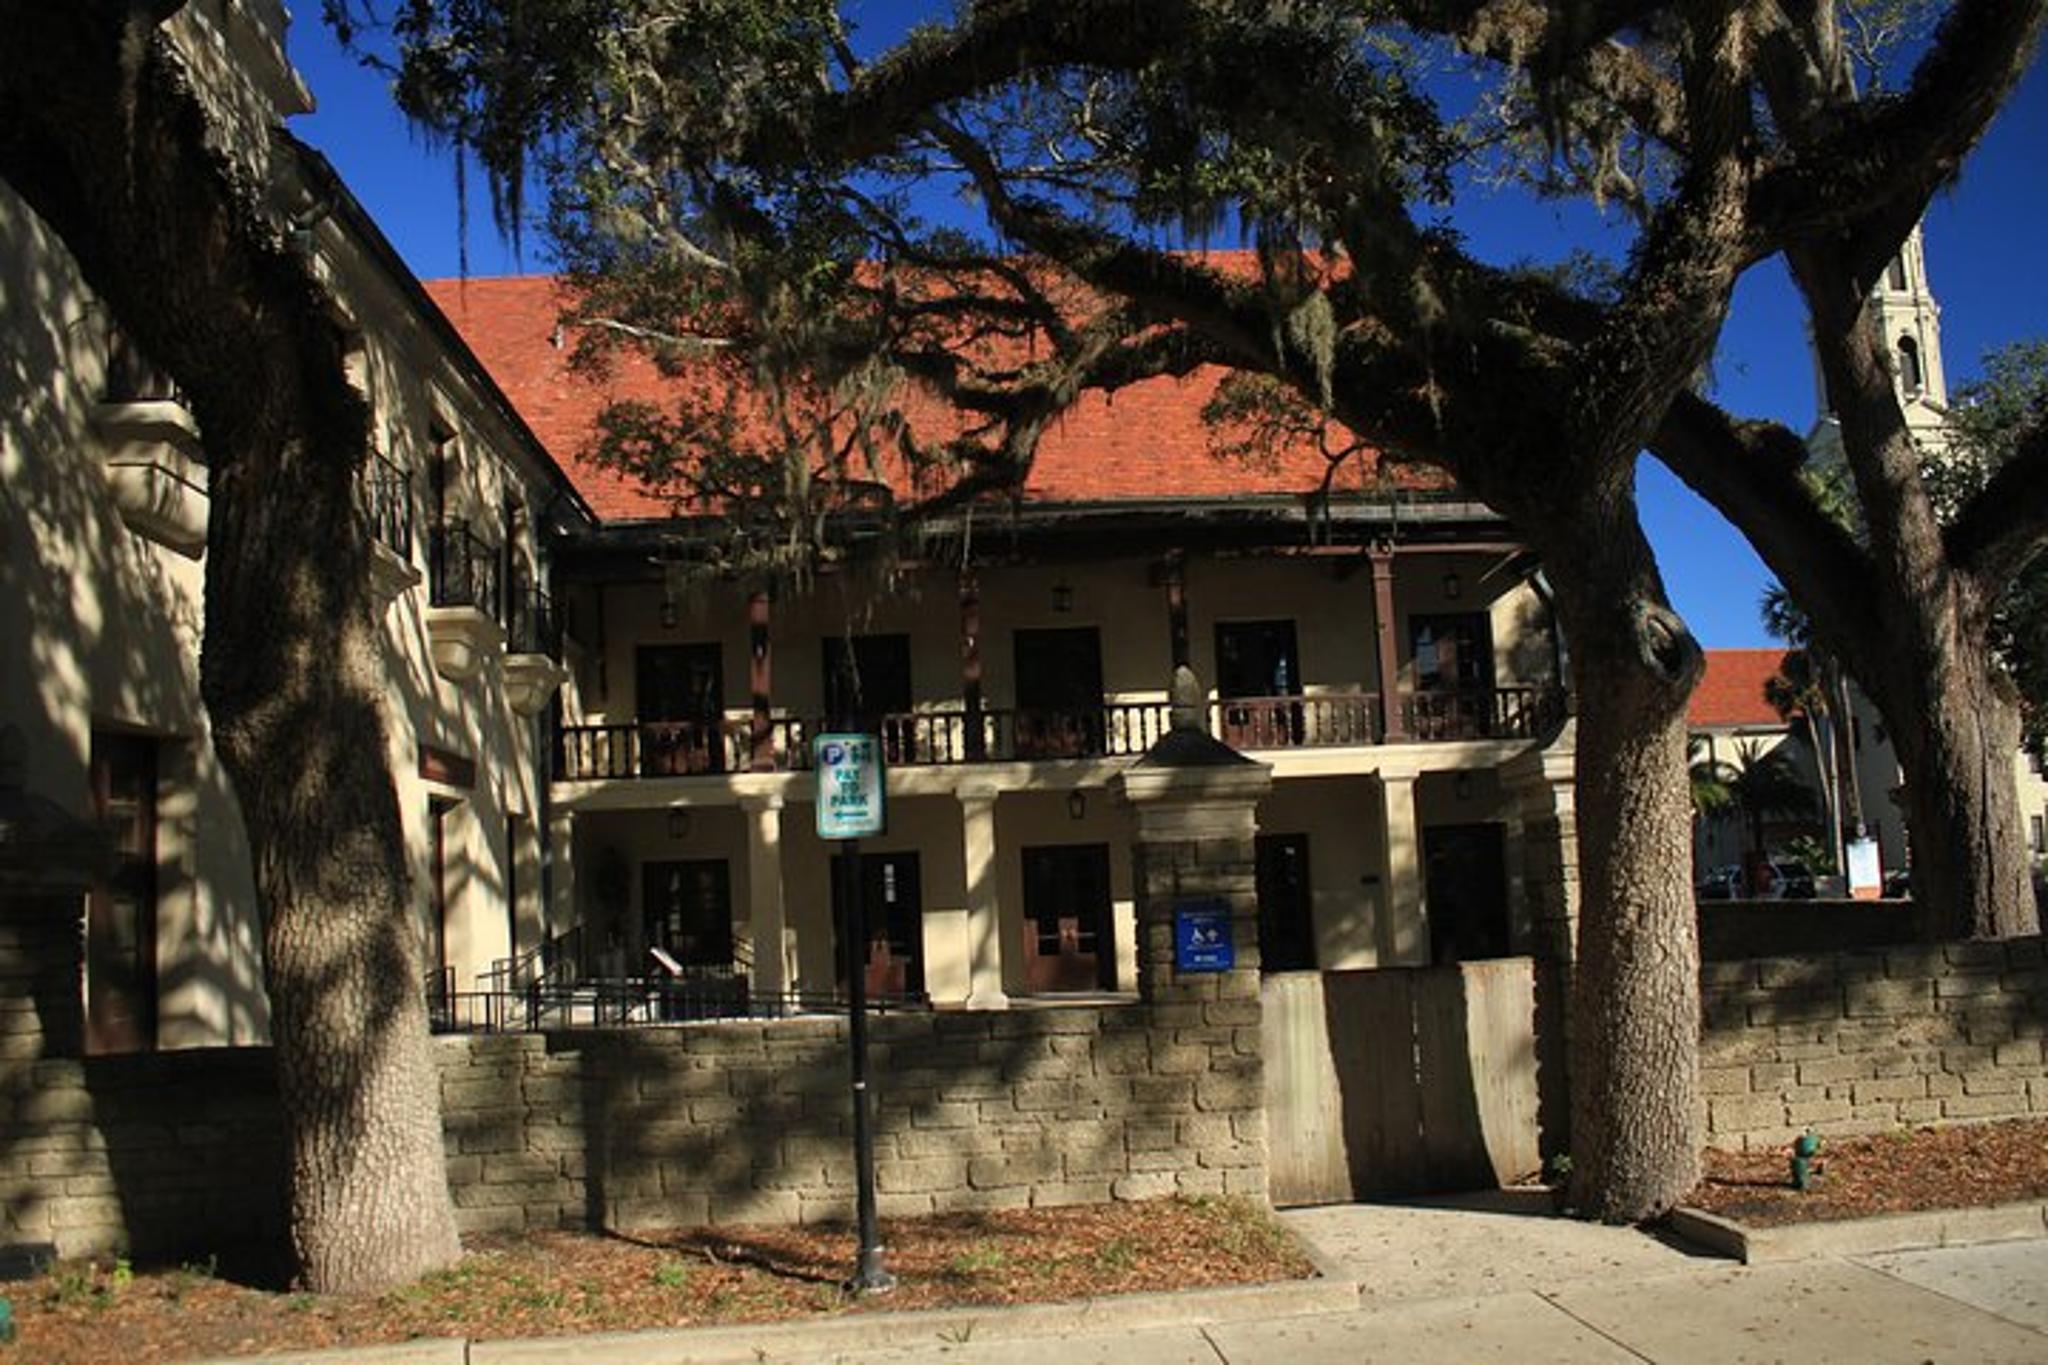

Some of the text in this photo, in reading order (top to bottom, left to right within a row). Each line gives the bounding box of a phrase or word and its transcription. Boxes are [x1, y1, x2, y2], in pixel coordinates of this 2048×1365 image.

[827, 747, 840, 762] P
[835, 769, 860, 781] PAY
[841, 781, 859, 793] TO
[830, 793, 868, 807] PARK
